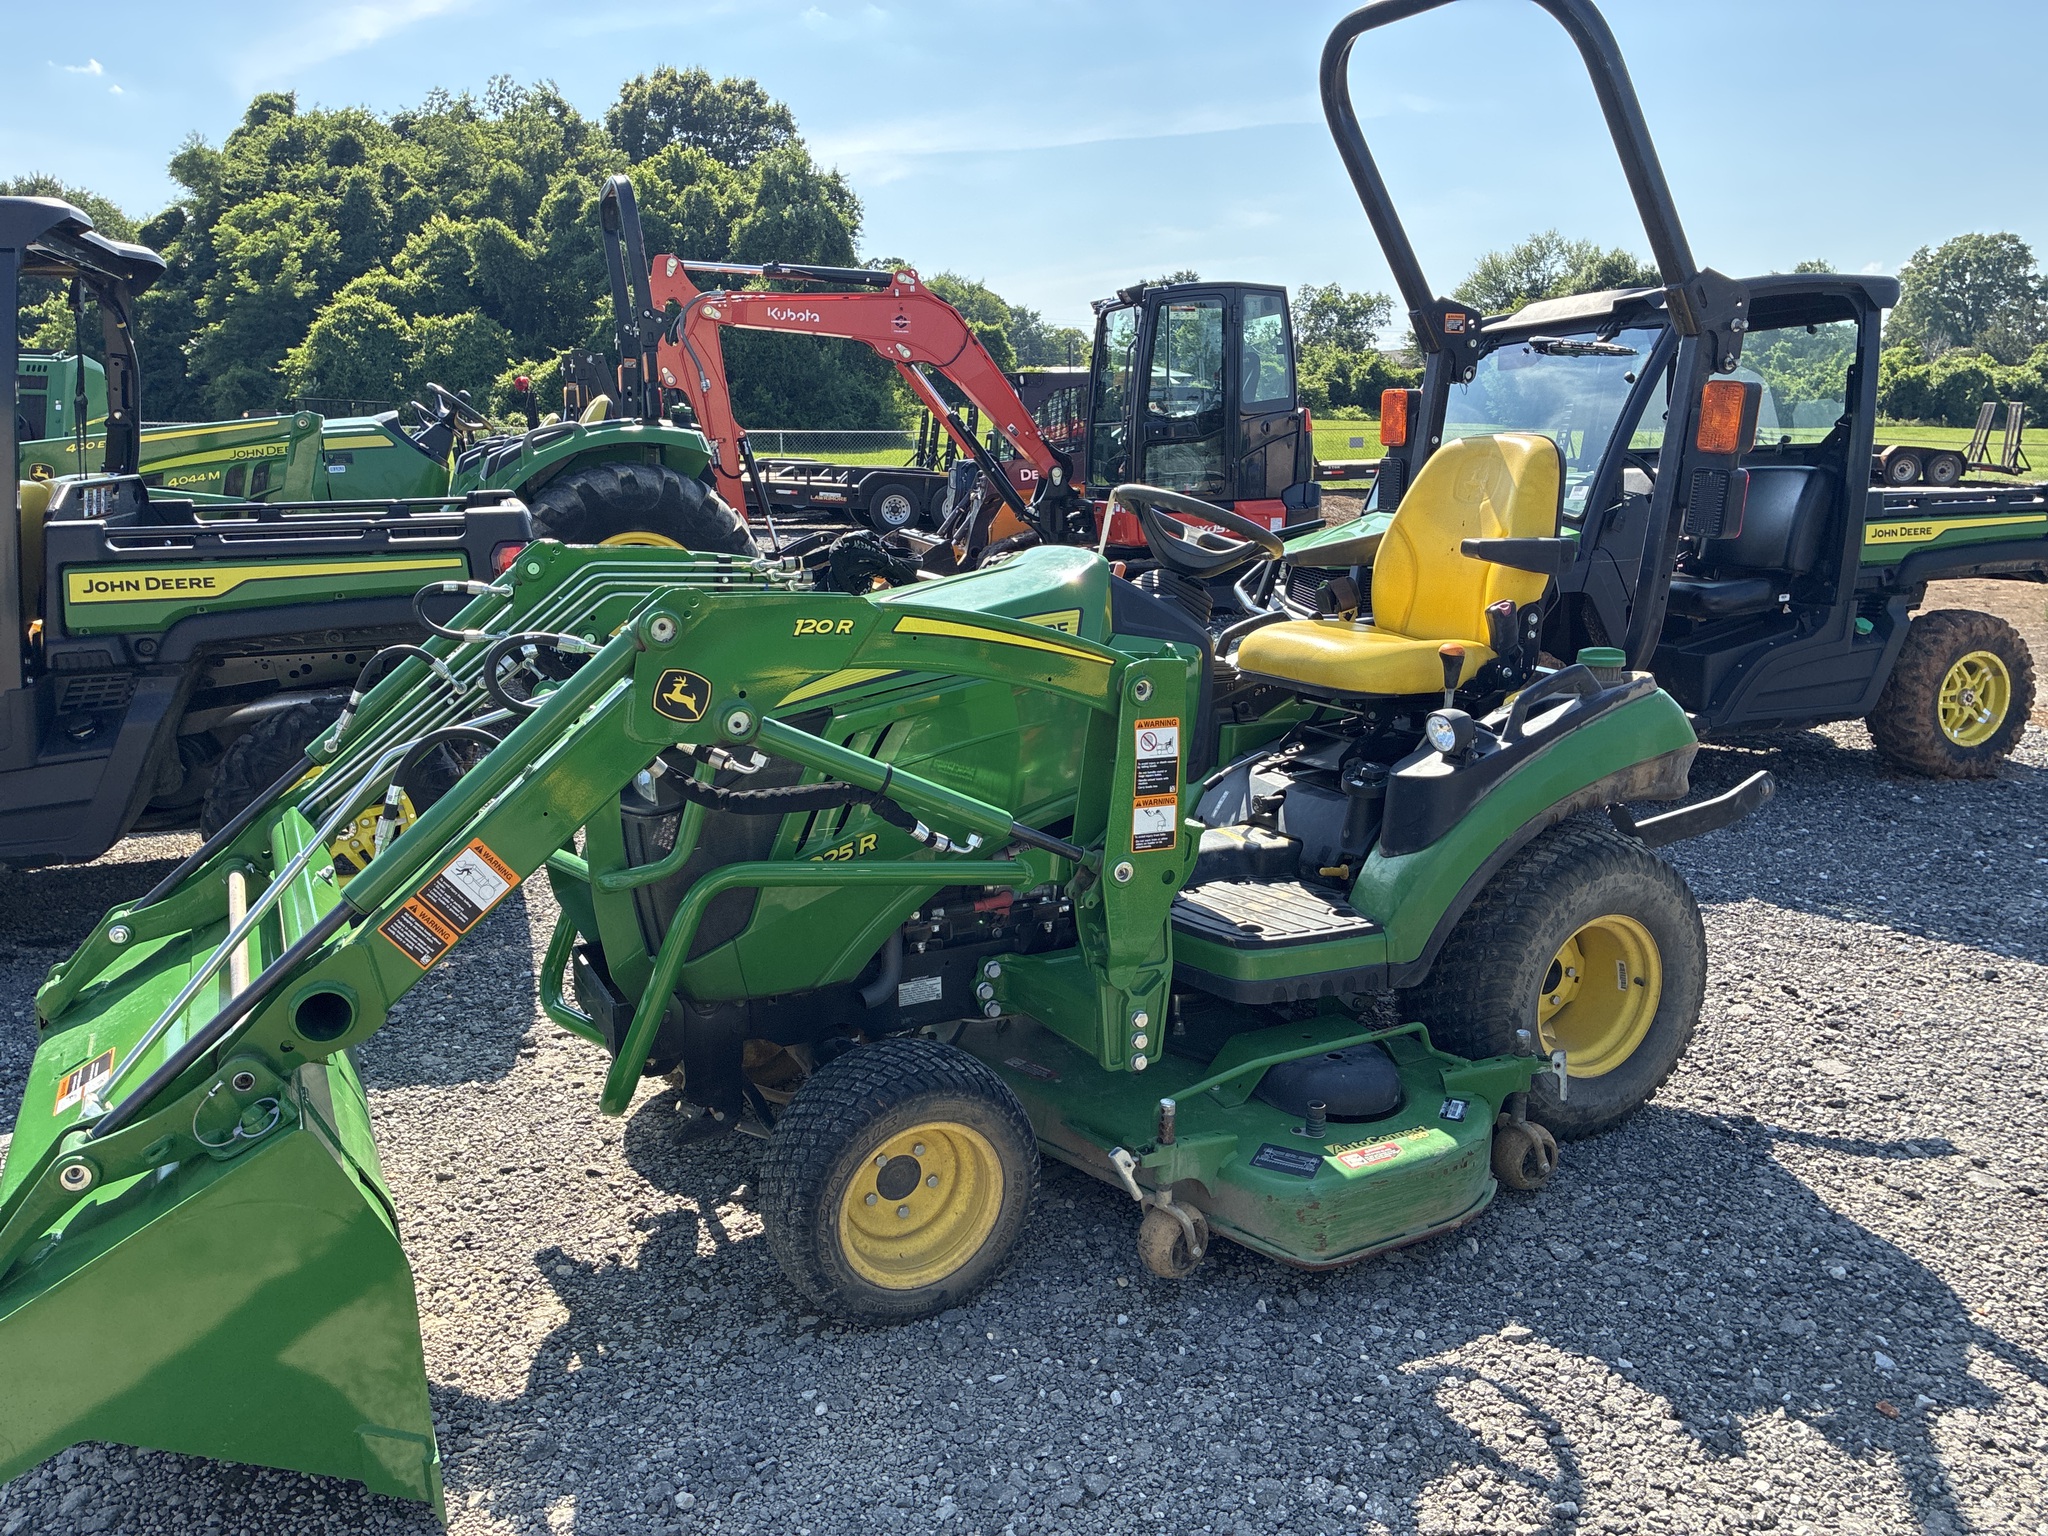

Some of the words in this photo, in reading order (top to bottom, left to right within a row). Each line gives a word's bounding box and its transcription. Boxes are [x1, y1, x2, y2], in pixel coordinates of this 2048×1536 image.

[767, 306, 820, 323] Kubota
[229, 448, 265, 460] JOHN
[167, 472, 207, 488] 4044
[208, 470, 221, 481] M
[1871, 528, 1898, 538] JOHN
[1900, 527, 1932, 536] DEERE
[83, 579, 140, 594] JOHN
[144, 577, 216, 591] DEERE
[793, 618, 835, 637] 120
[835, 618, 855, 635] R
[1143, 718, 1177, 728] WARNING
[1142, 798, 1175, 806] WARNING
[859, 833, 878, 855] R
[483, 851, 514, 881] WARNING
[418, 910, 451, 941] WARNING
[1332, 1124, 1427, 1155] AutoConnect
[817, 1229, 848, 1289] MULTI
